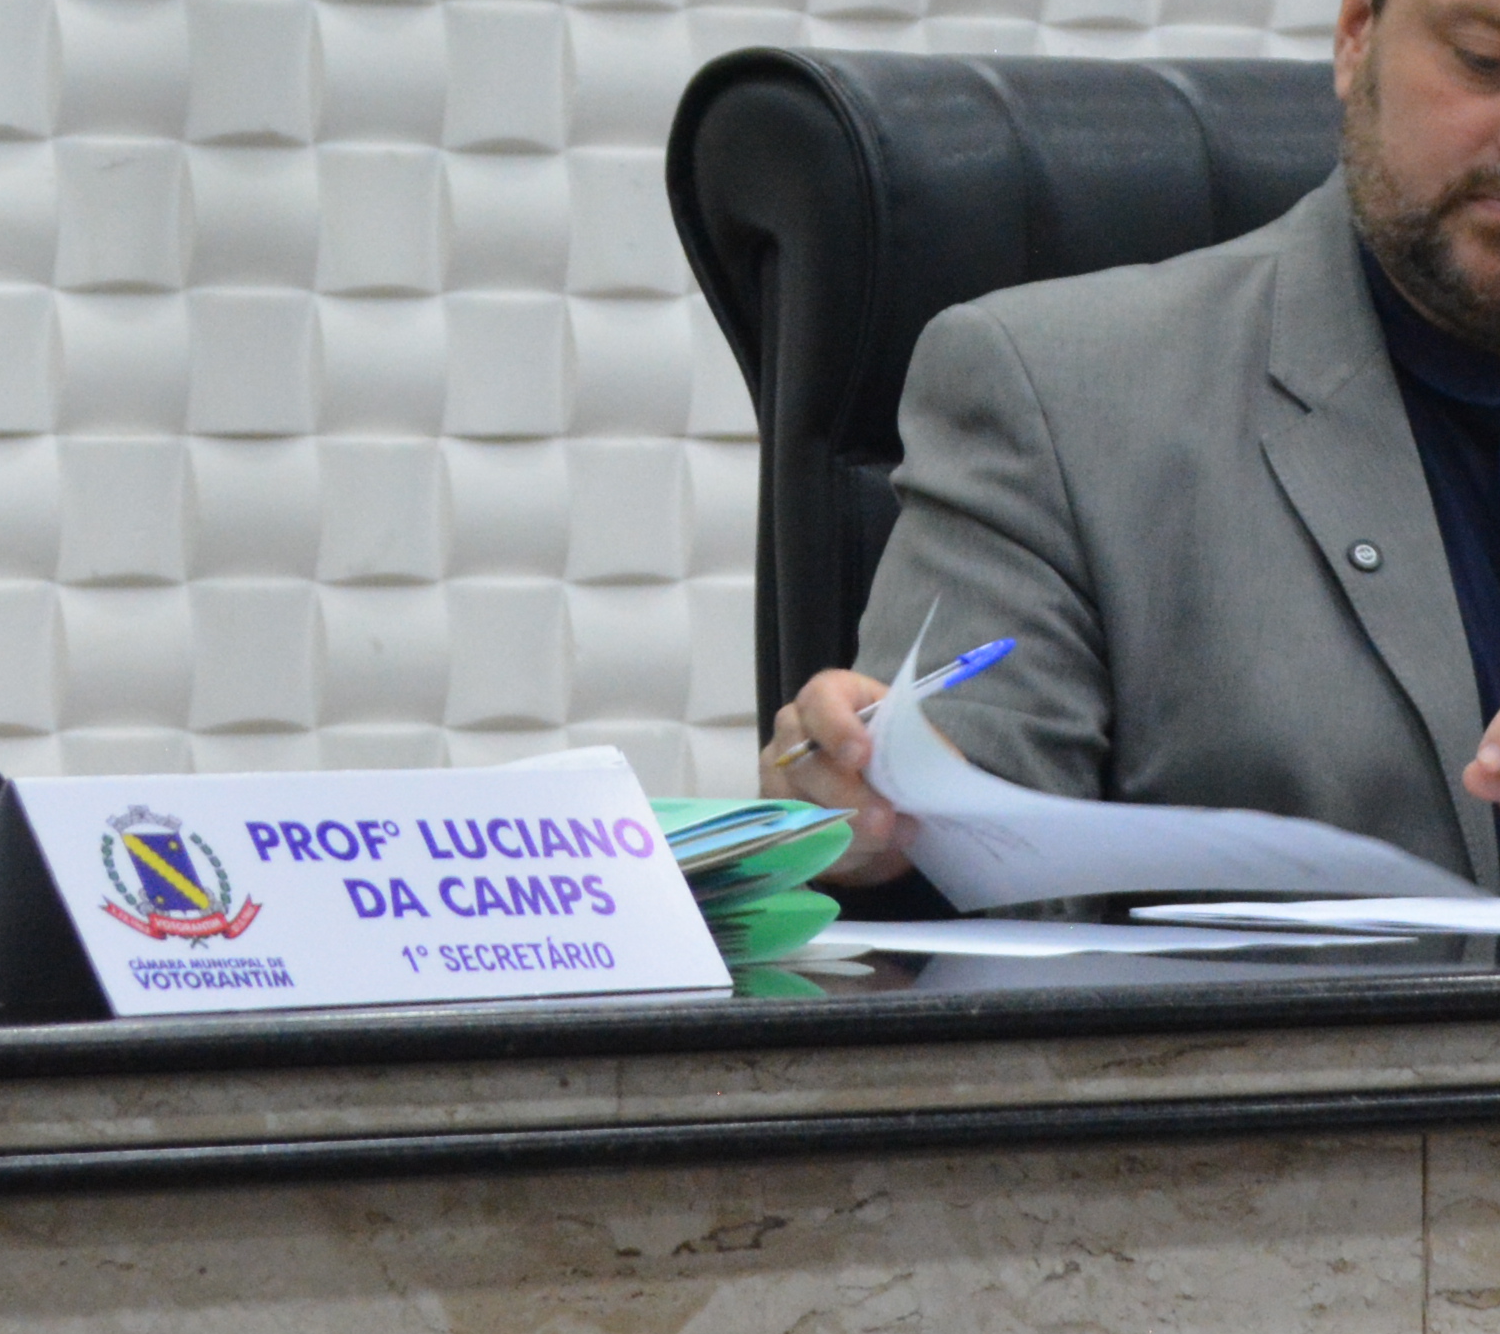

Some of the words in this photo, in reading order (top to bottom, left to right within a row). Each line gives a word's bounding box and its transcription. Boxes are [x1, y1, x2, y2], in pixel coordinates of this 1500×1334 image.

[416, 817, 656, 861] LUCIANO
[343, 877, 431, 919] DA
[438, 874, 617, 918] CAMPS
[155, 917, 222, 932] VOTORANTIM
[128, 957, 186, 970] CÂMARA
[188, 957, 264, 969] MUNICIPAL
[267, 957, 285, 968] DE
[438, 936, 617, 973] SECRETÁRIO
[133, 969, 295, 990] VOTORANTIM
